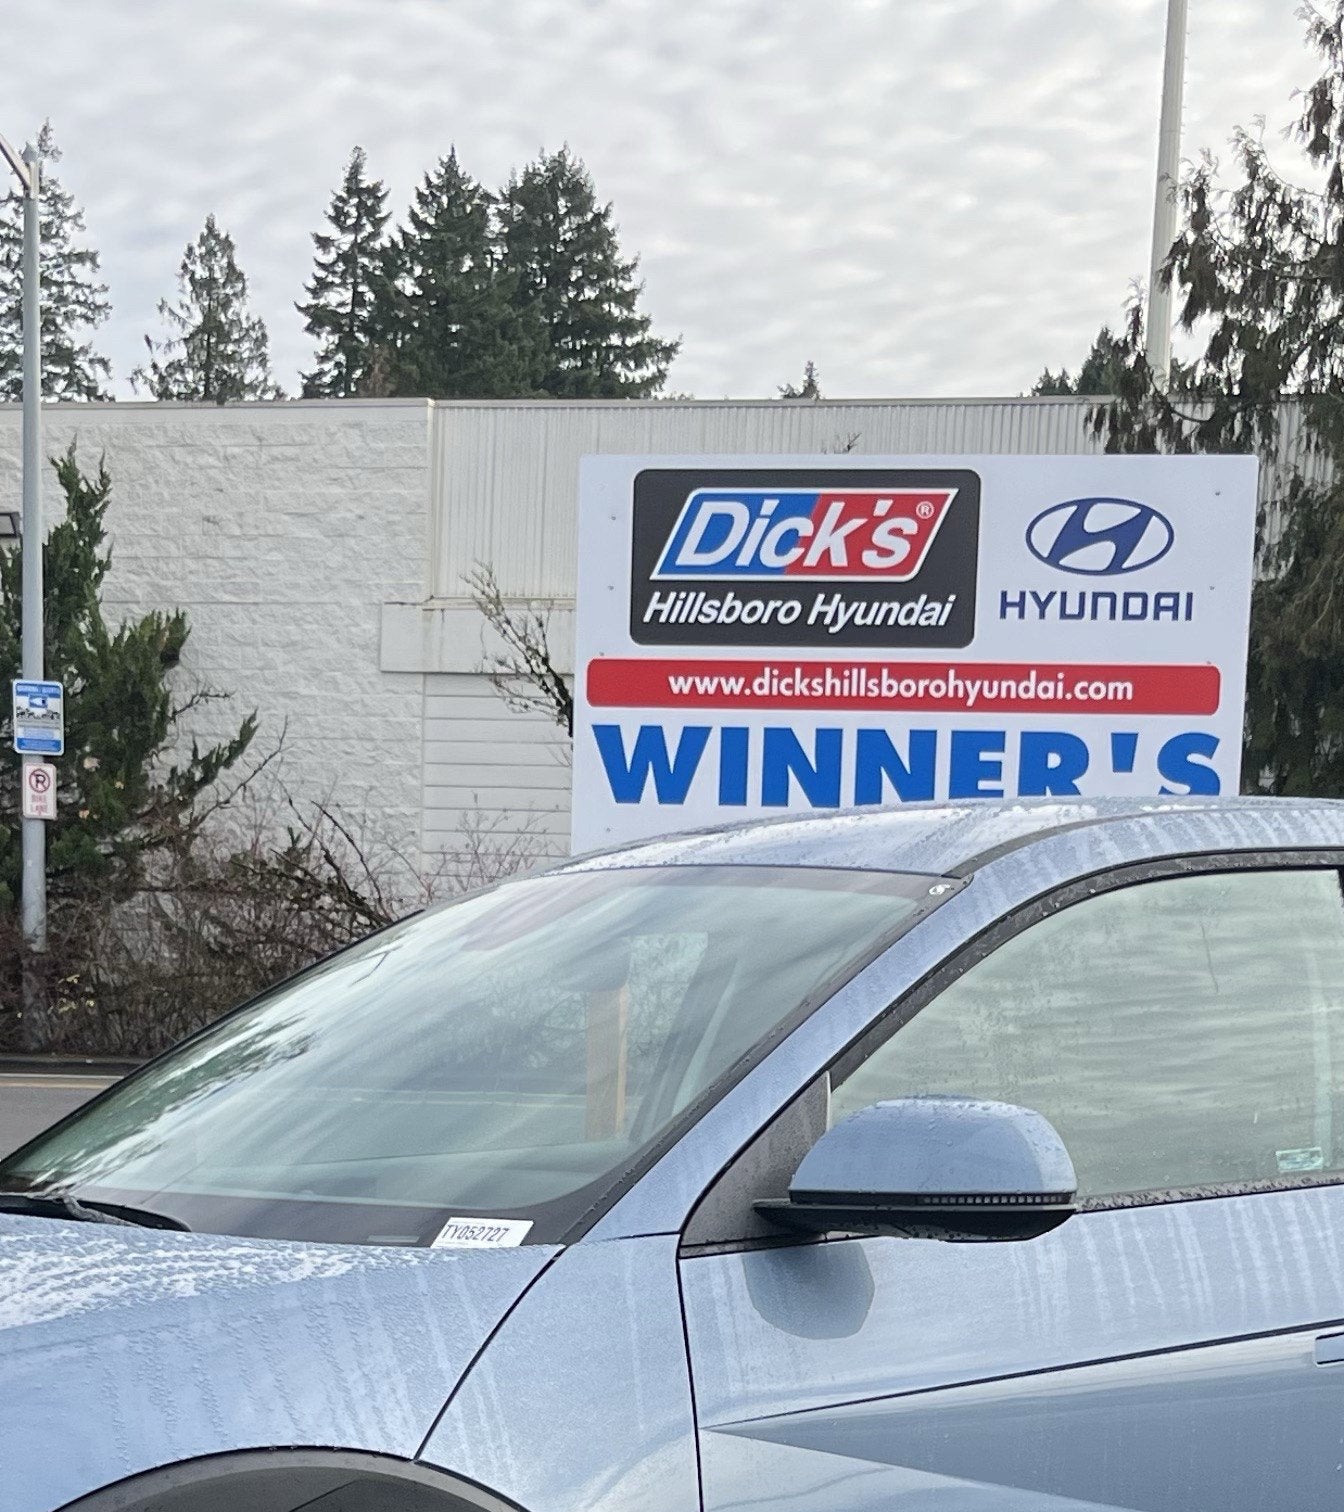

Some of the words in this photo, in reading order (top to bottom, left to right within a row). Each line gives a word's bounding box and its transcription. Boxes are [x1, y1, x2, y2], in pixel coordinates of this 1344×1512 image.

[674, 498, 919, 569] Dick's
[642, 590, 802, 626] Hillsboro
[807, 592, 957, 634] Hyundai
[999, 589, 1194, 622] HYUNDAI
[668, 668, 1134, 707] www.dickshillsborohyundai.com
[590, 723, 1222, 808] WINNER'S
